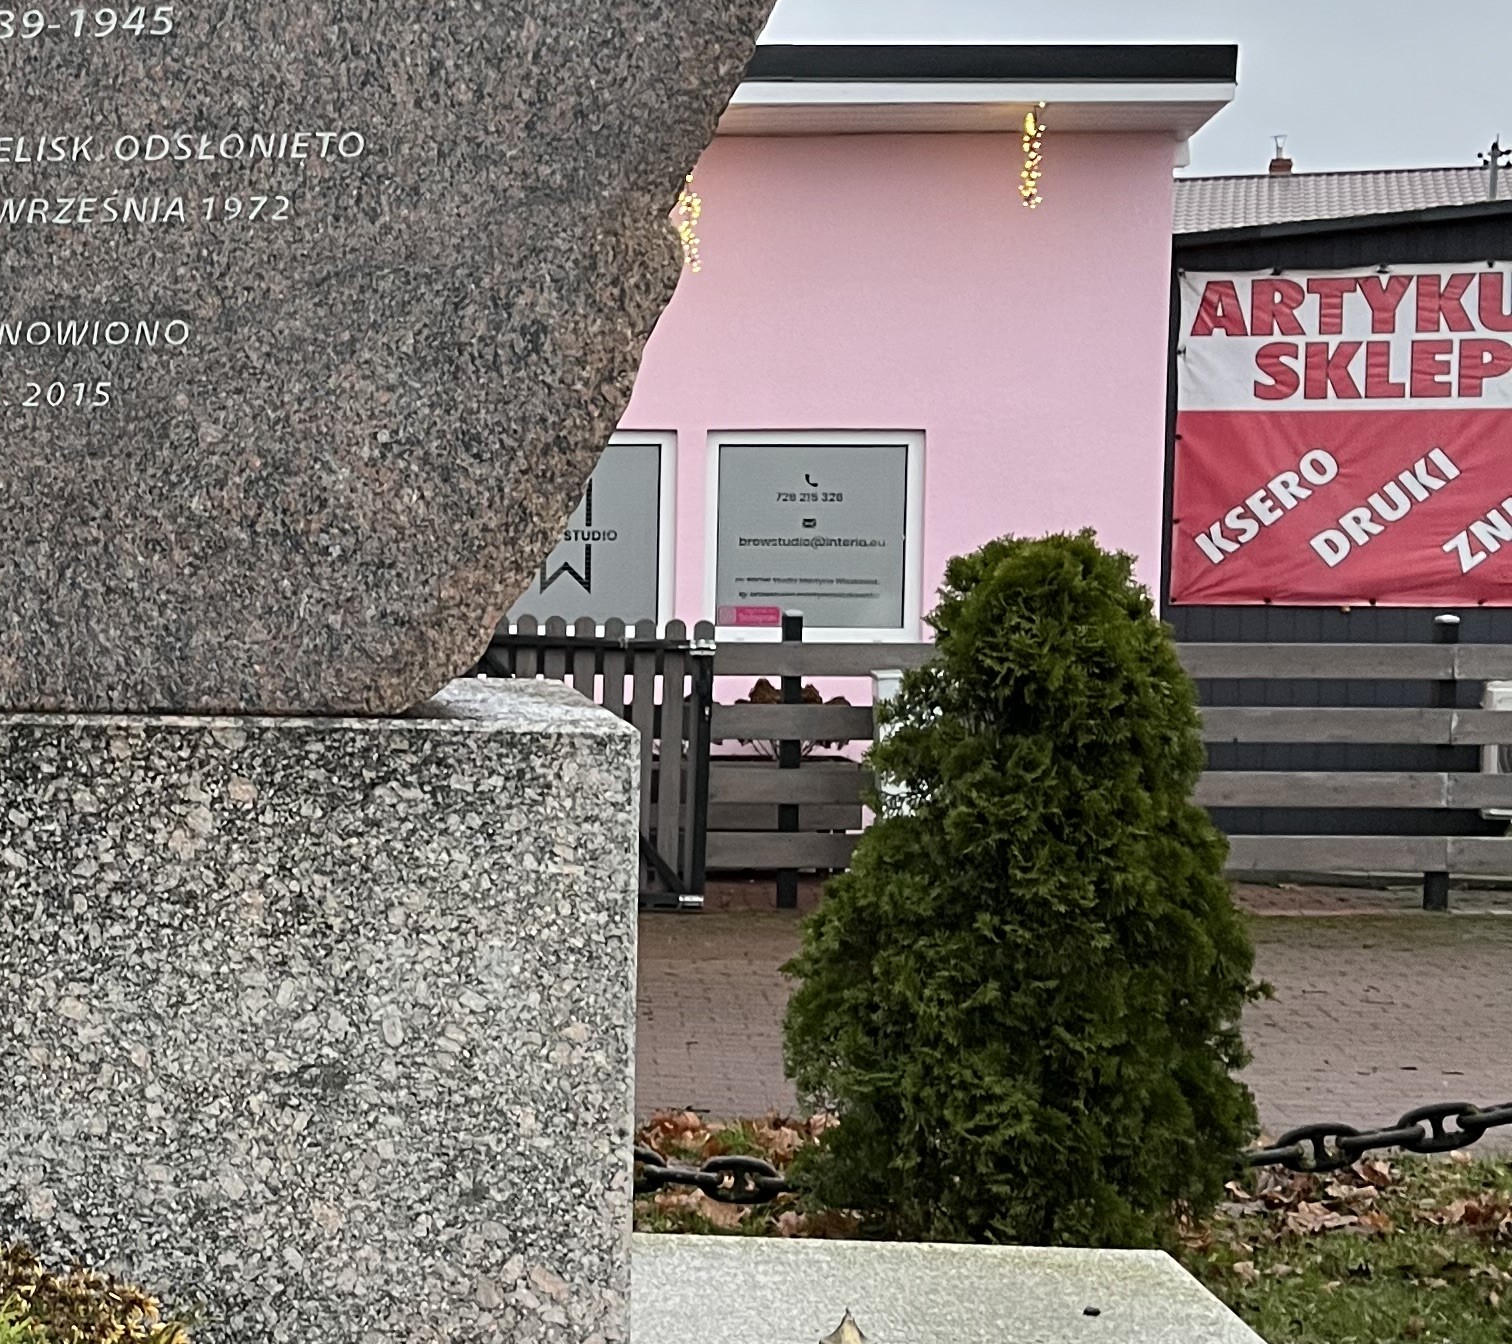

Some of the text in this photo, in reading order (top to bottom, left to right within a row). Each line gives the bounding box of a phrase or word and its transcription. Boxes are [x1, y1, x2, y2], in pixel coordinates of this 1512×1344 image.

[202, 194, 290, 221] 1972
[21, 381, 112, 408] 2015
[1253, 339, 1512, 400] SKLEP
[563, 529, 618, 542] STUDIO
[1194, 448, 1339, 564] KSERO
[1310, 447, 1461, 568] DRUKI
[1442, 495, 1512, 574] ZN
